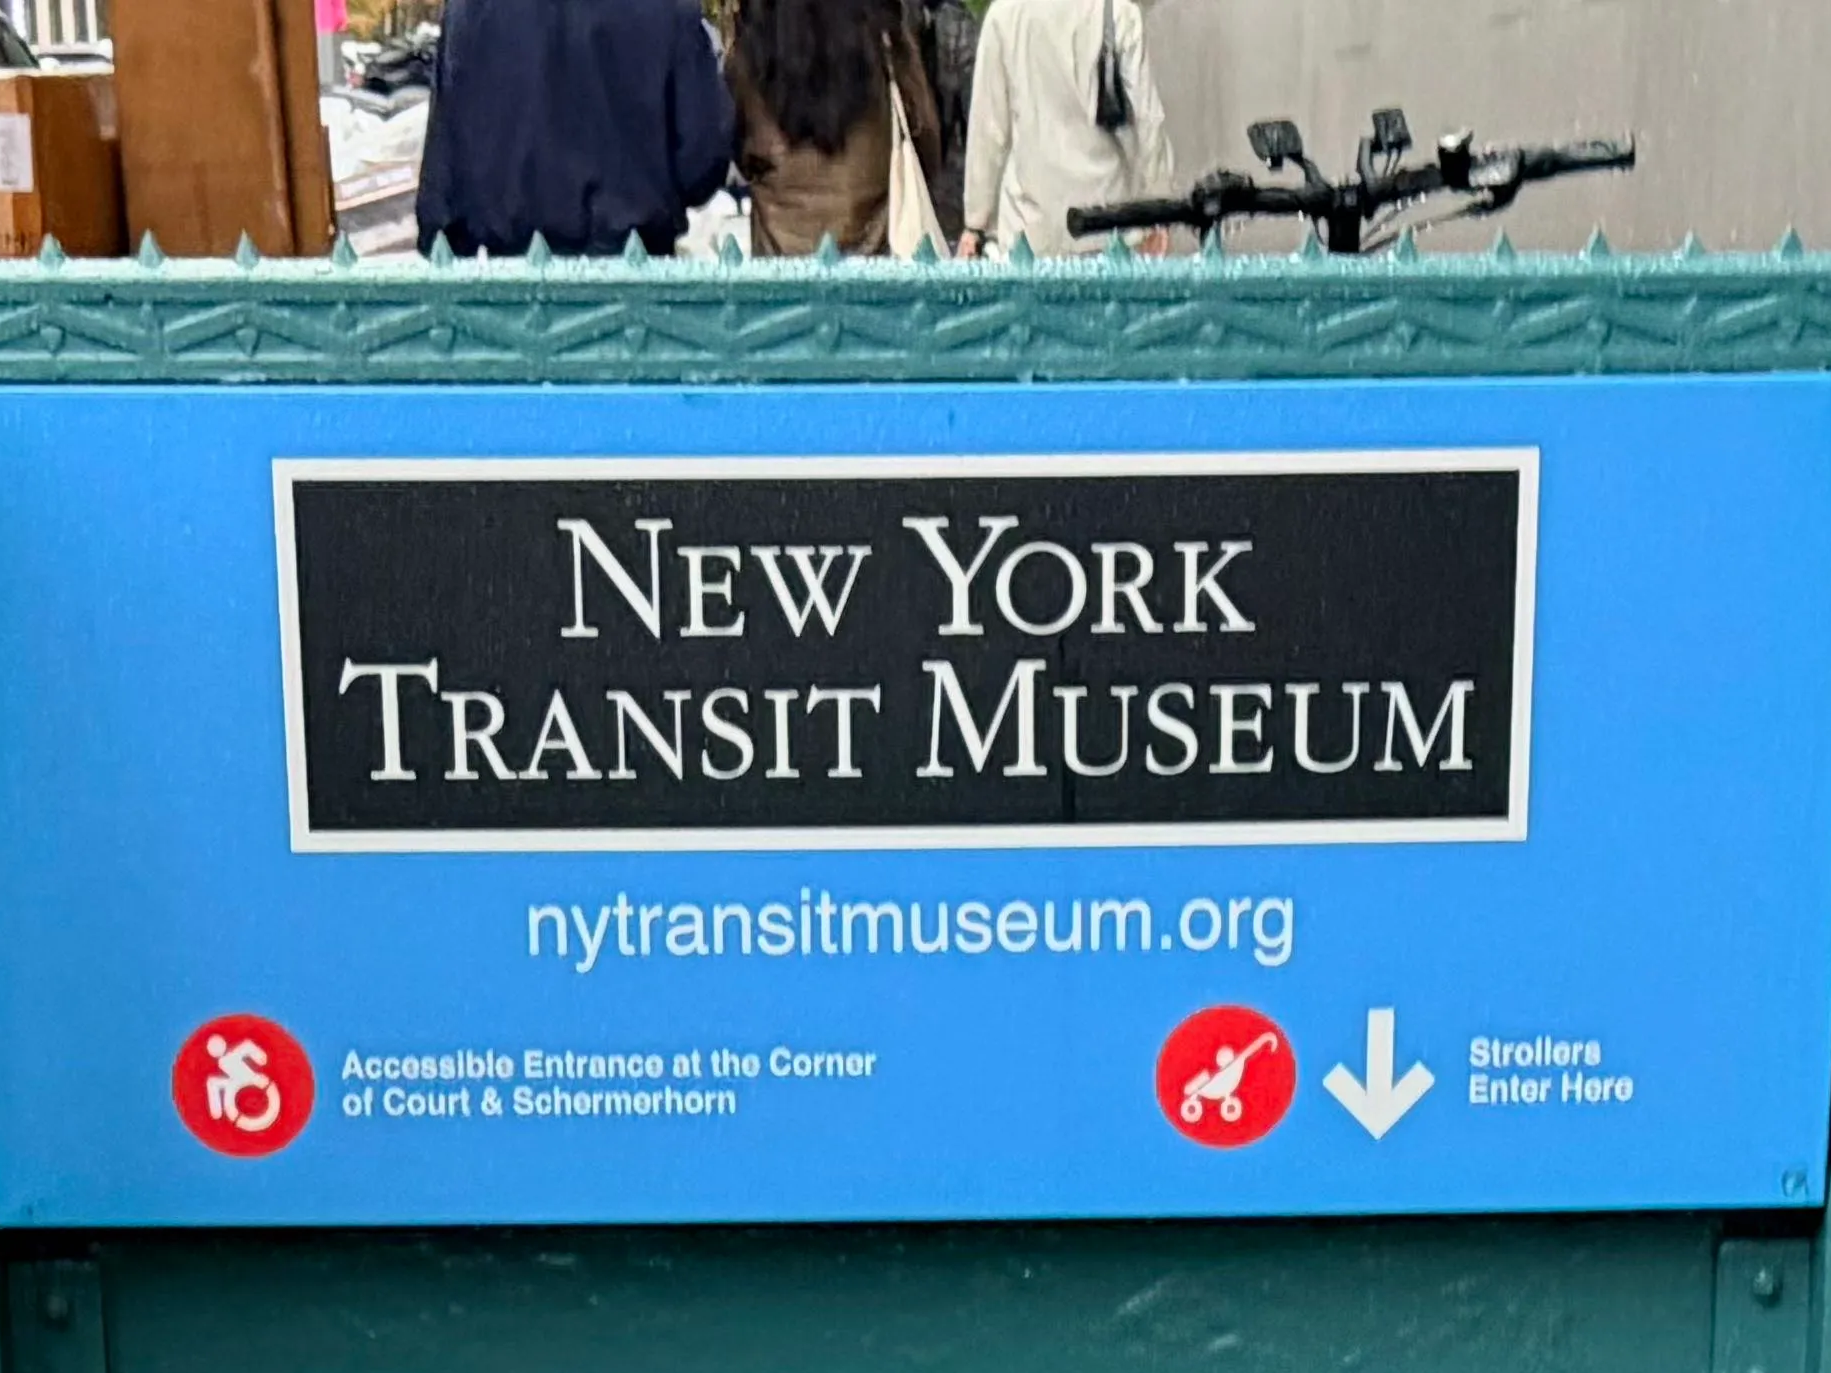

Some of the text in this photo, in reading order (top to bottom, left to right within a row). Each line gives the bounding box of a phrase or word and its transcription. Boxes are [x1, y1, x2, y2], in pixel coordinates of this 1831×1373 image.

[528, 886, 1294, 973] nytransitmuseum.org
[341, 1047, 876, 1080] Accessible Entrance at the Corner
[1470, 1036, 1601, 1068] Strollers
[342, 1085, 736, 1116] of Court & Schermerhorn
[1470, 1072, 1634, 1104] Enter Here
